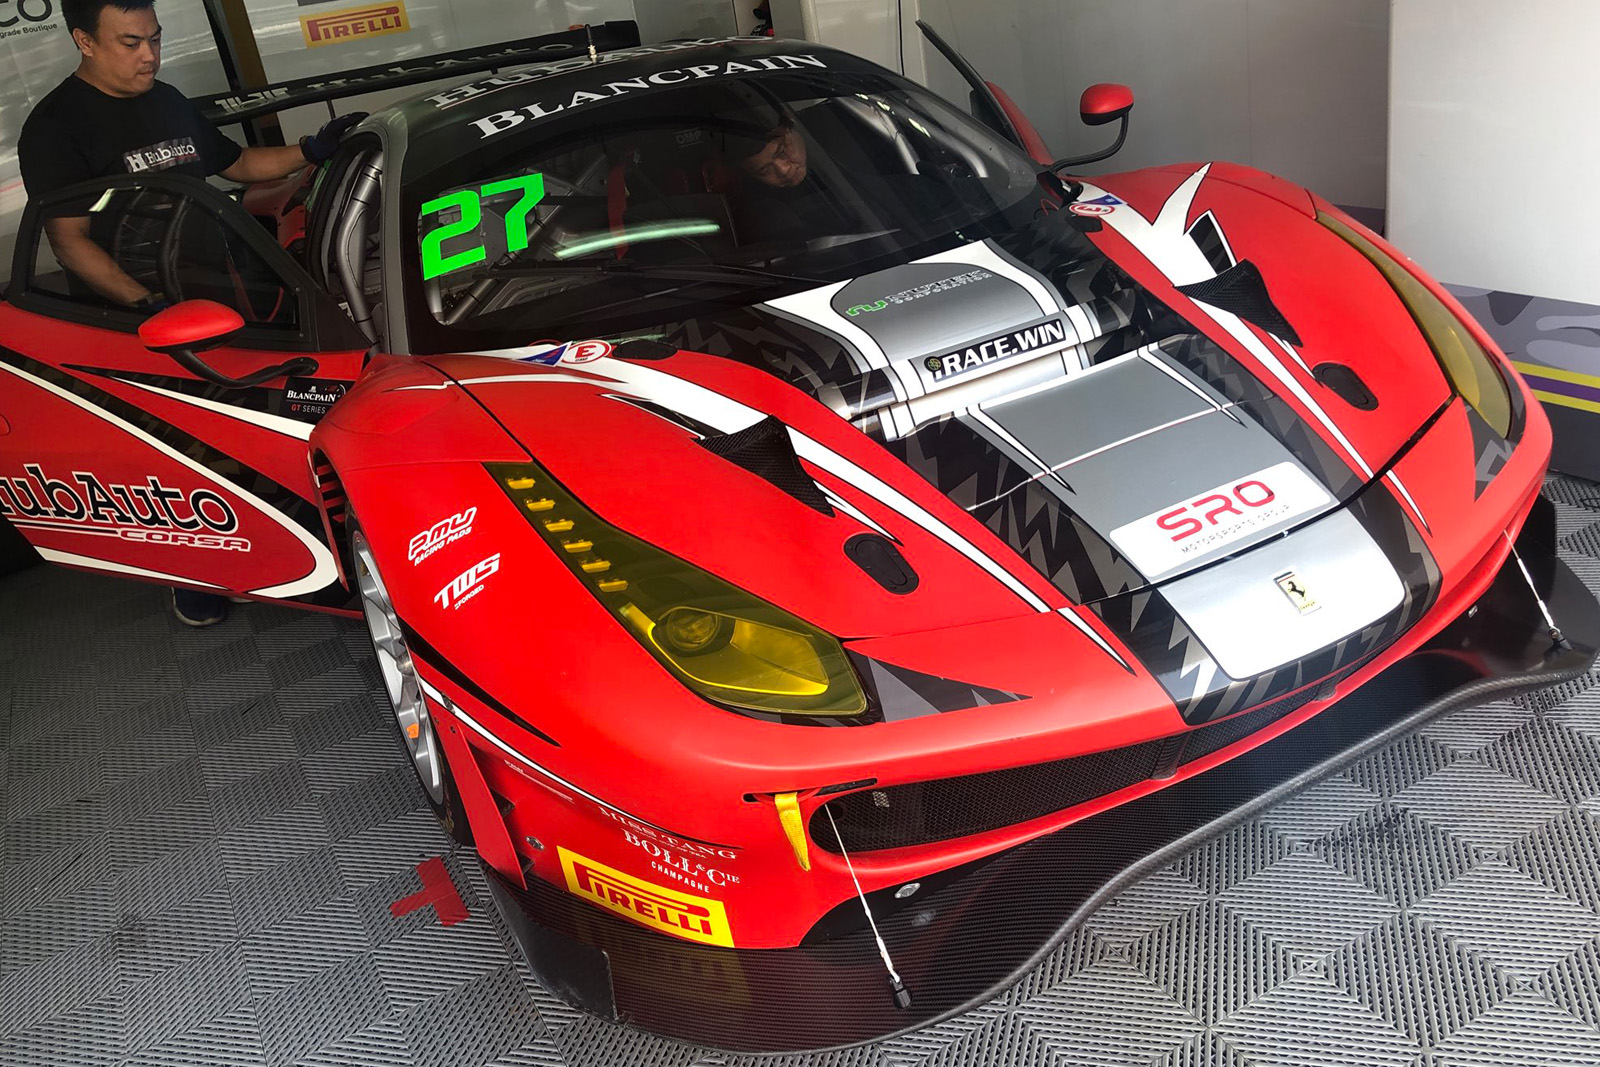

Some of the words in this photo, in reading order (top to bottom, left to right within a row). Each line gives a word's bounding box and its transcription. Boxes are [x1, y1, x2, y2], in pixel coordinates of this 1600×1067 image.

[22, 23, 58, 34] Boutique
[306, 6, 402, 42] PIRELLI
[468, 54, 828, 139] BLANCPAIN
[145, 144, 196, 164] HubAuto
[421, 172, 545, 281] 27
[575, 345, 597, 358] E
[286, 389, 337, 402] BLANCPAIN
[291, 403, 302, 412] GT
[302, 404, 326, 414] SERIES
[0, 463, 239, 534] ubAuto
[1156, 480, 1275, 542] SRO
[117, 528, 251, 552] CORSA
[408, 506, 477, 561] PMU
[414, 540, 446, 567] RACING
[446, 526, 473, 545] PADS
[434, 552, 501, 610] TWS
[661, 834, 738, 860] TANG
[651, 860, 710, 893] CHAMPAGNE
[572, 860, 713, 936] PIRELLI
